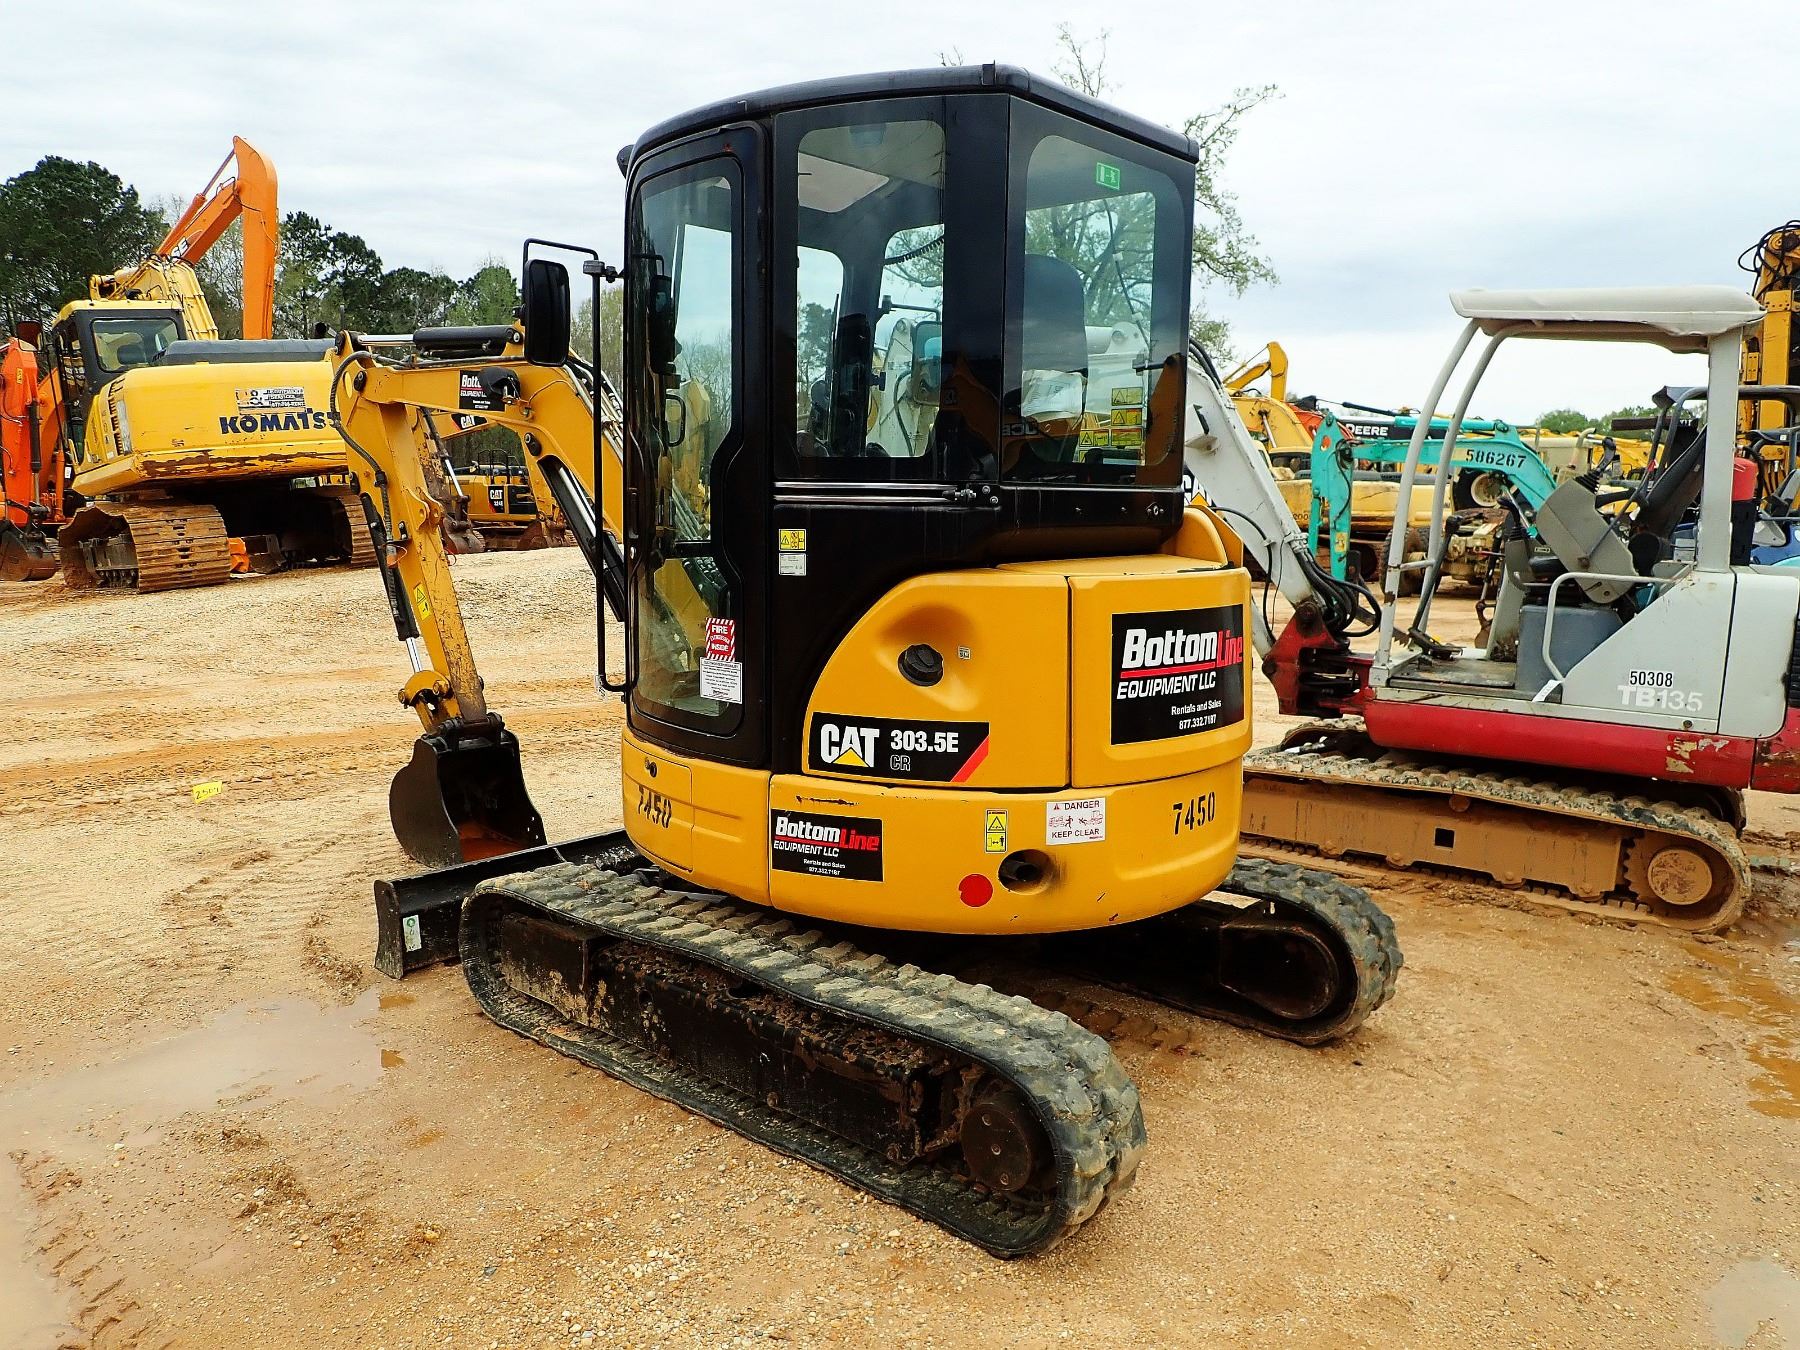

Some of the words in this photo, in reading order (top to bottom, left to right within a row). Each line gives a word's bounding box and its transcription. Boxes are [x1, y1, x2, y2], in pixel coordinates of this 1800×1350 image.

[460, 415, 475, 429] CAT
[1345, 424, 1388, 436] DEERE
[1466, 449, 1527, 468] 586267
[490, 490, 503, 500] CAT
[711, 624, 728, 634] FIRE
[711, 643, 728, 652] INSIDE
[1116, 674, 1198, 700] EQUIPMENT
[1199, 671, 1217, 691] LLC
[1629, 671, 1673, 688] 50308
[1617, 685, 1703, 712] TB135
[1171, 704, 1196, 716] Rentals
[1197, 701, 1207, 711] and
[1208, 699, 1222, 709] Sales
[1179, 714, 1217, 730] 877.332.7187
[820, 723, 880, 768] CAT
[890, 729, 959, 753] 303.5E
[889, 754, 911, 771] CR
[638, 783, 672, 828] 7450
[1064, 800, 1100, 811] DANGER
[1173, 791, 1215, 835] 7450
[1051, 831, 1073, 839] KEEP
[1074, 828, 1100, 837] CLEAR
[773, 840, 823, 855] EQUIPMENT
[823, 847, 840, 857] LLC
[803, 858, 821, 867] Rentals
[831, 861, 845, 869] Sales
